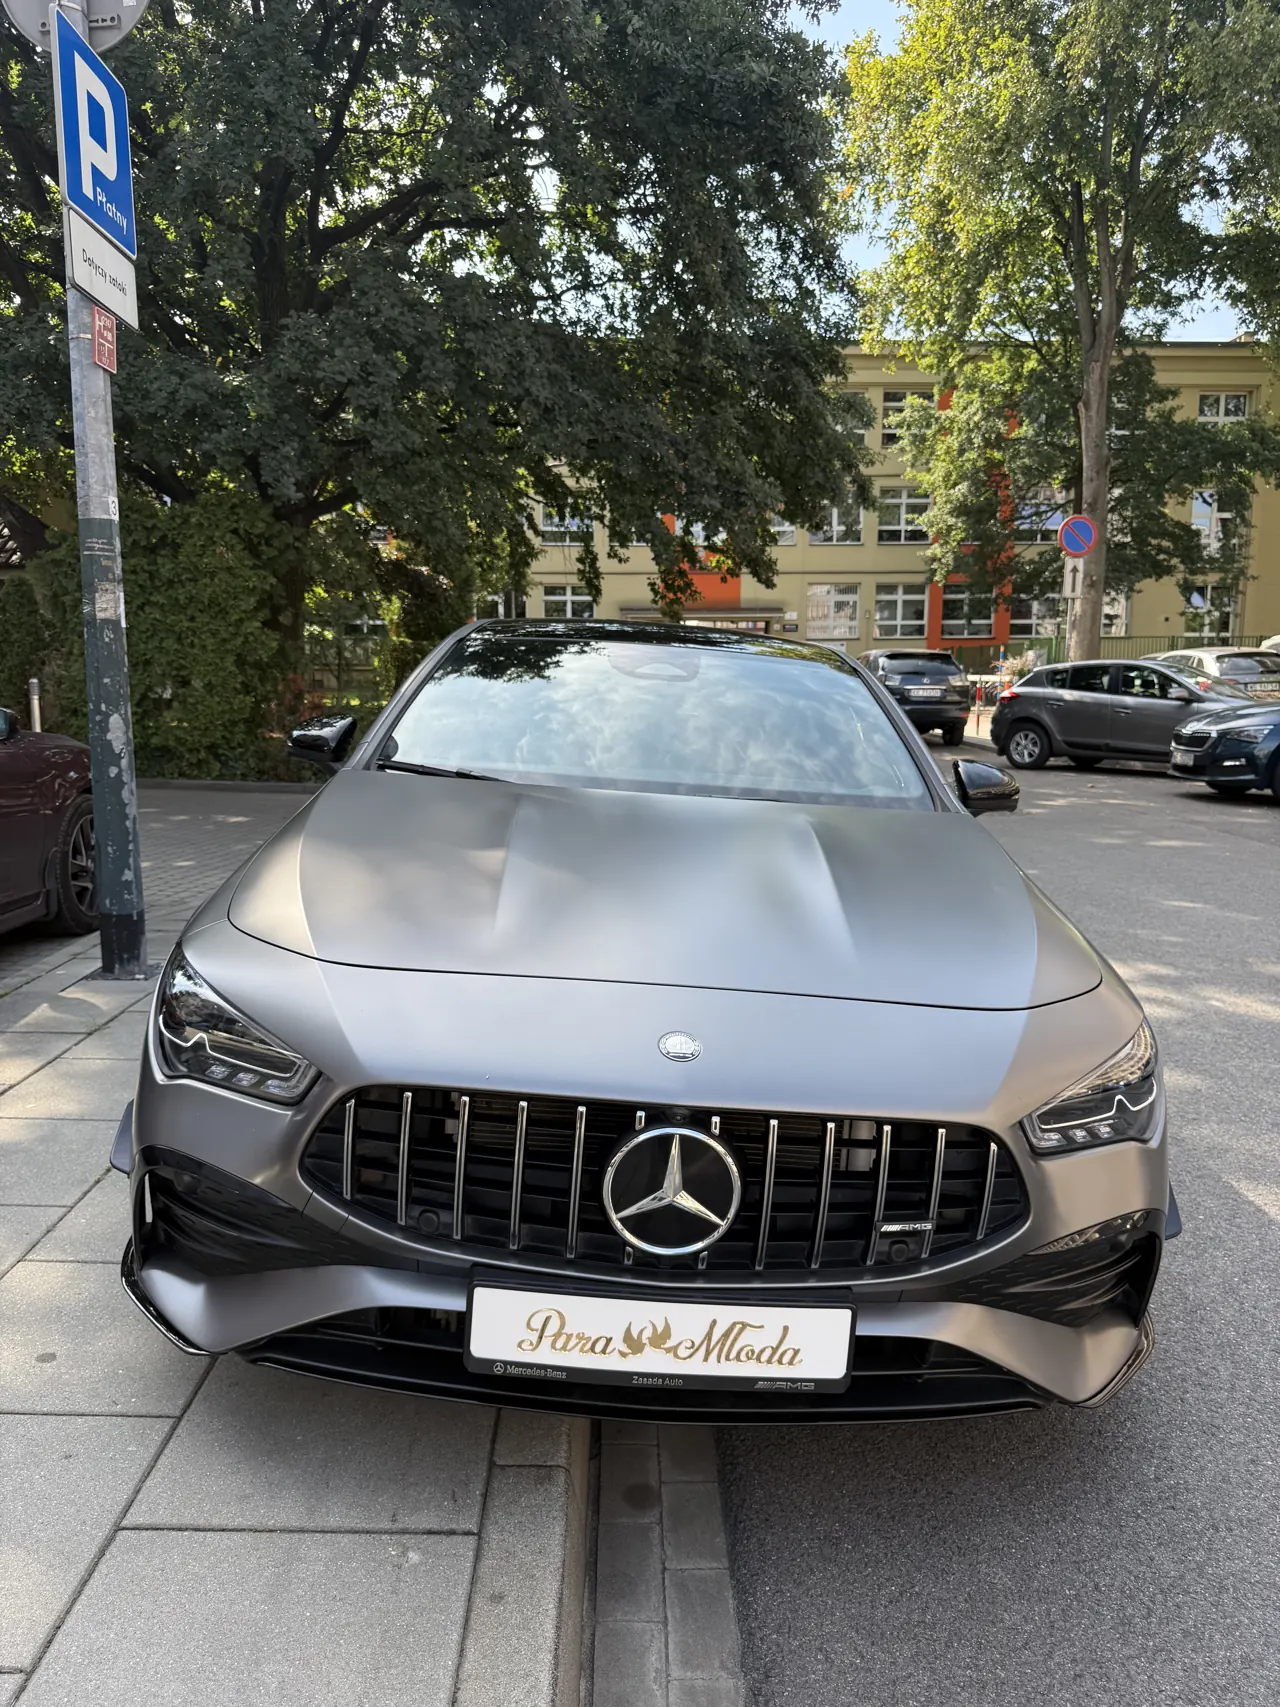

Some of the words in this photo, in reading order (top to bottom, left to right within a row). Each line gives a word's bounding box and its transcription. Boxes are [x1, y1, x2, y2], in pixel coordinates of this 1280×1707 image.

[74, 51, 118, 201] P
[82, 248, 107, 283] Dotyczy
[109, 275, 127, 296] zatoki
[897, 1223, 932, 1231] AMG
[516, 1307, 616, 1356] Para
[506, 1364, 567, 1379] Mercedes-Benz
[632, 1375, 663, 1386] Zasada
[664, 1377, 684, 1387] Auto
[770, 1381, 815, 1391] AMG
